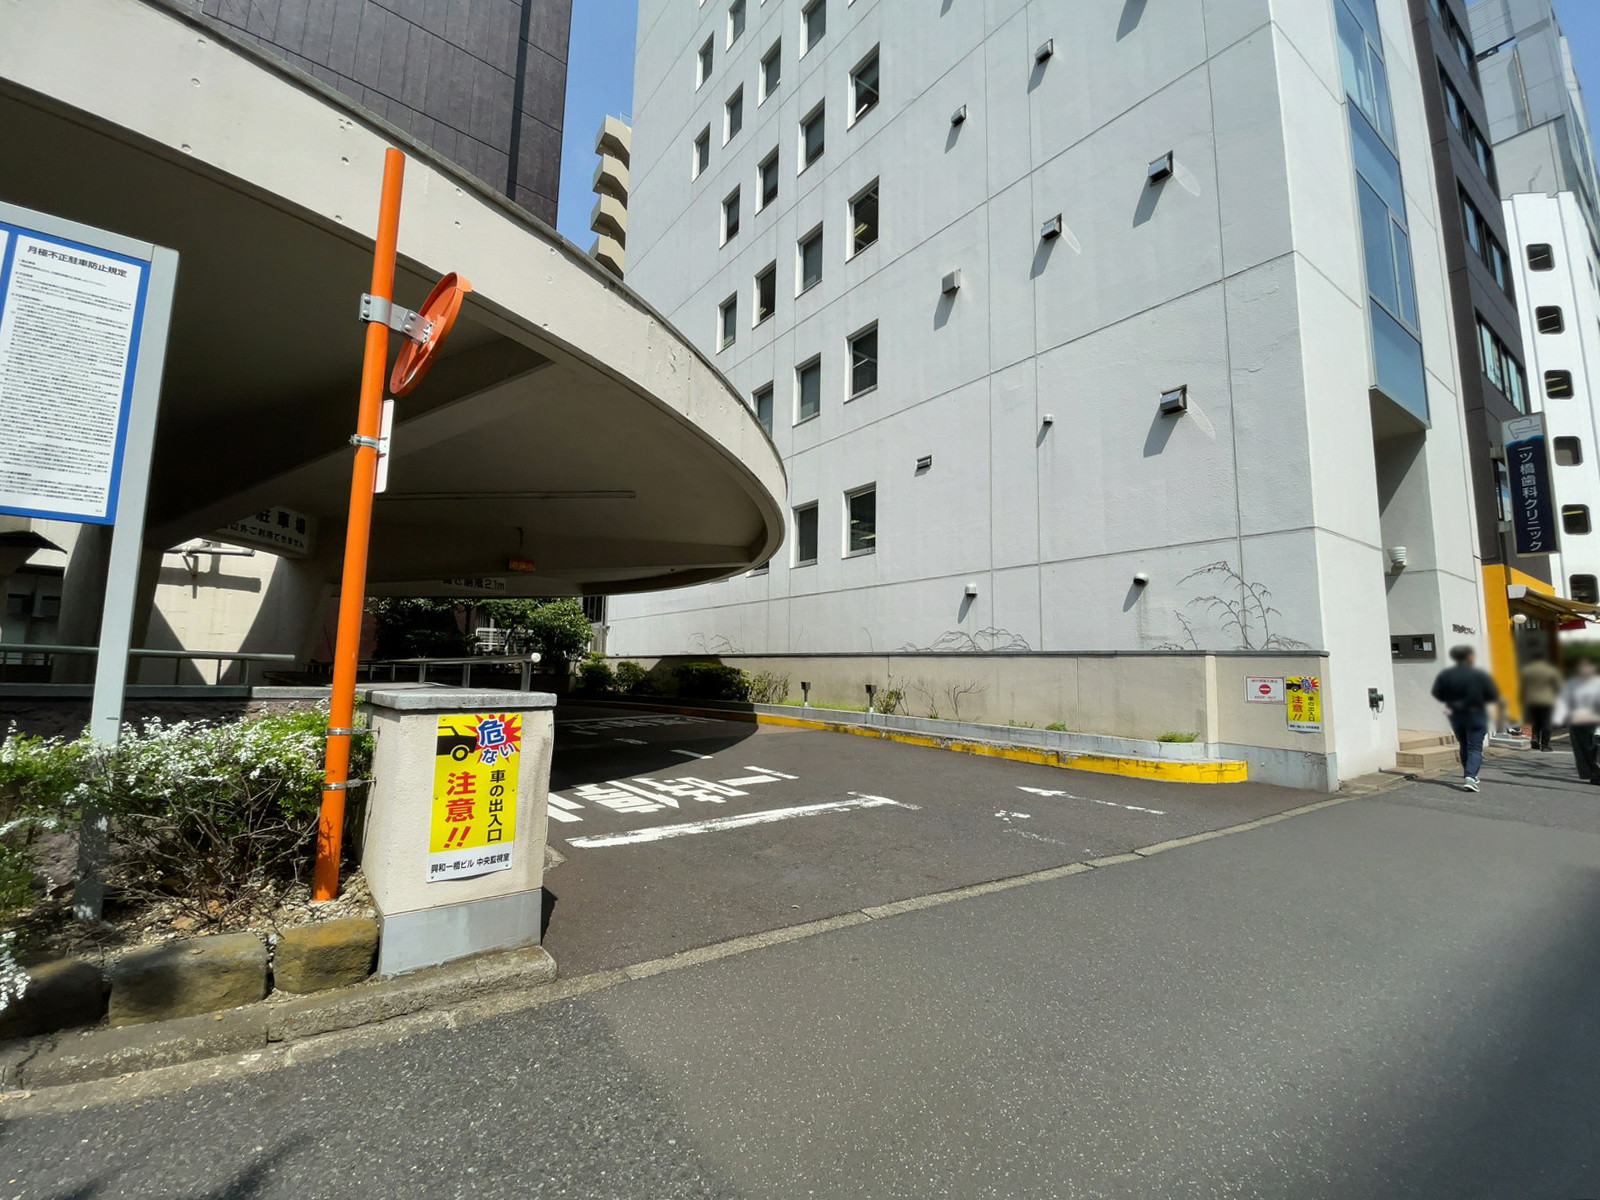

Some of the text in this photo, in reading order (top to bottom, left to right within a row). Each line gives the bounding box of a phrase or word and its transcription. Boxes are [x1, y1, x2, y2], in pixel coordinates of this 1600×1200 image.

[27, 245, 128, 278] 月極不正駐車防止規定
[1518, 445, 1542, 552] 一ツ橋歯科クリニック
[477, 718, 515, 765] 危ない
[487, 769, 506, 843] 車の出入口
[476, 852, 510, 867] 中央監視室
